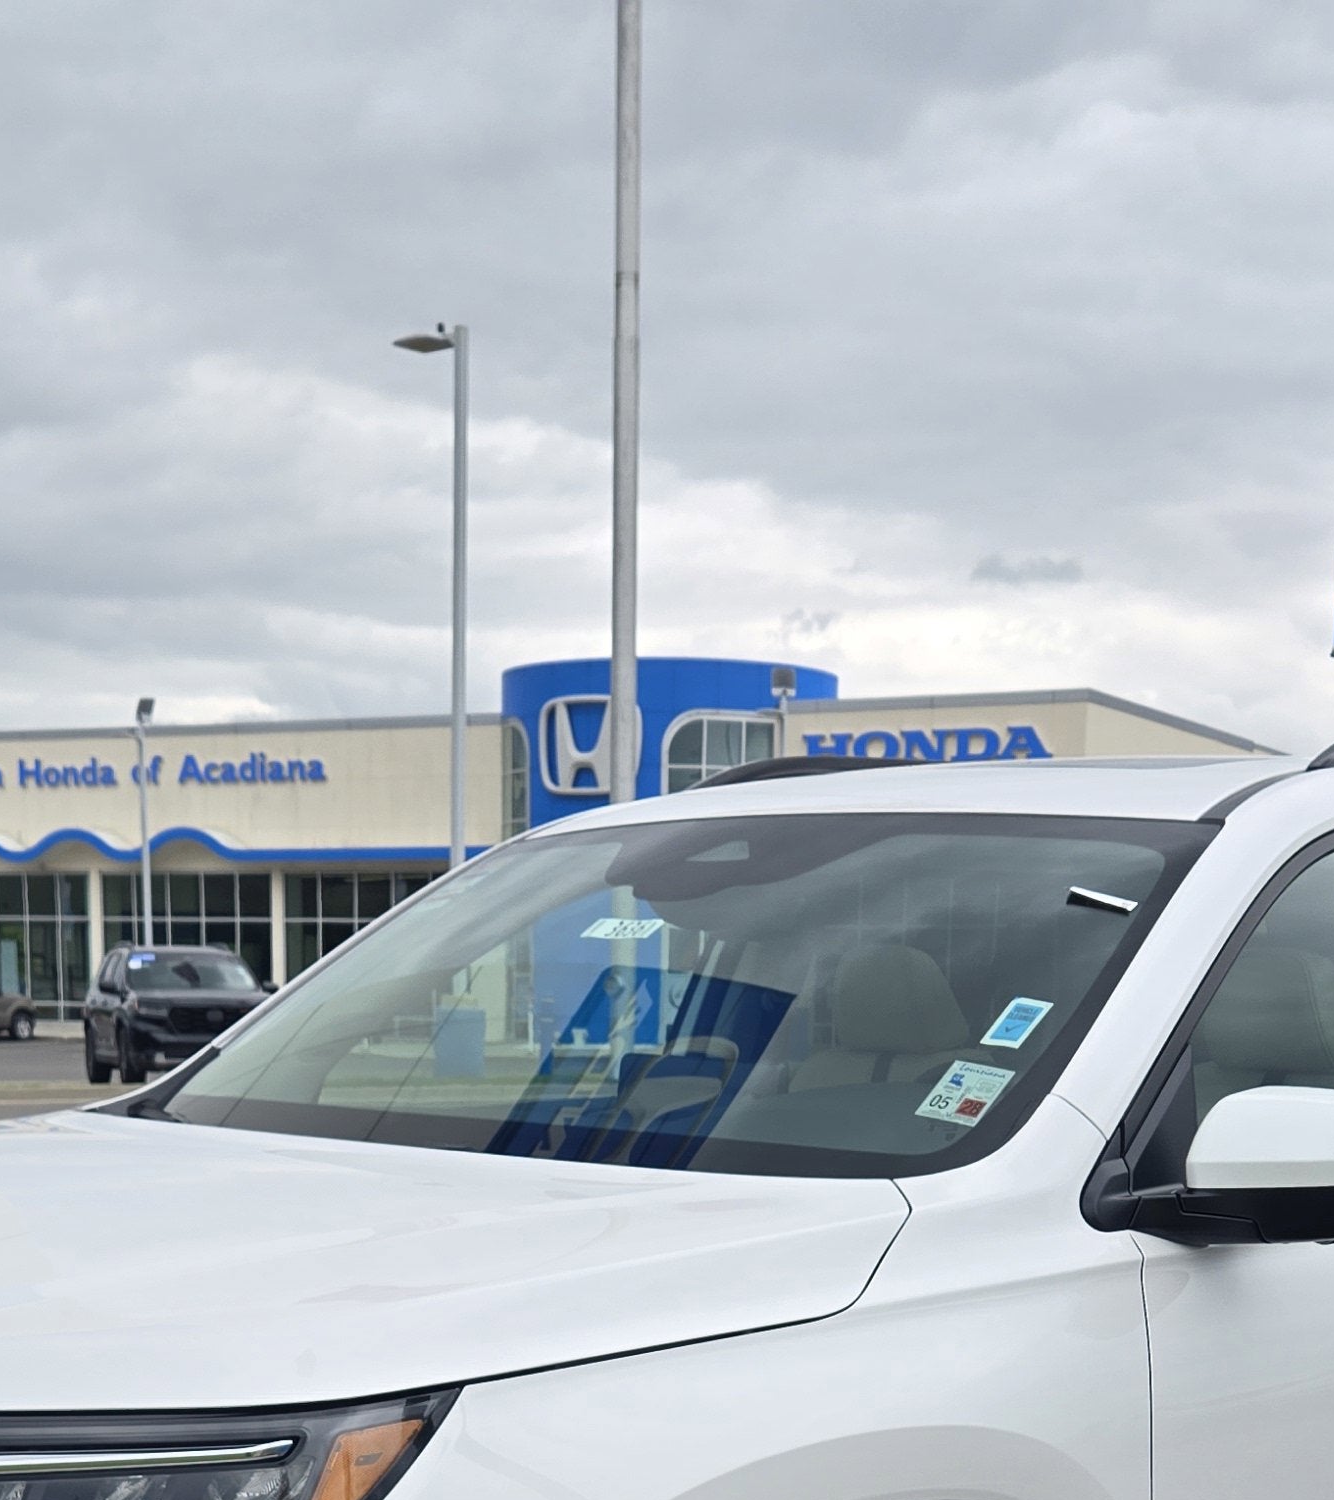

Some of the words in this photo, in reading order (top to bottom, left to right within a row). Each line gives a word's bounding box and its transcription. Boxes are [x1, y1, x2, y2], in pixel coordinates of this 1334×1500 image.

[802, 726, 1053, 762] HONDA
[18, 757, 118, 788] Honda
[131, 755, 163, 786] of
[178, 752, 327, 785] Acadiana
[929, 1094, 952, 1110] 05
